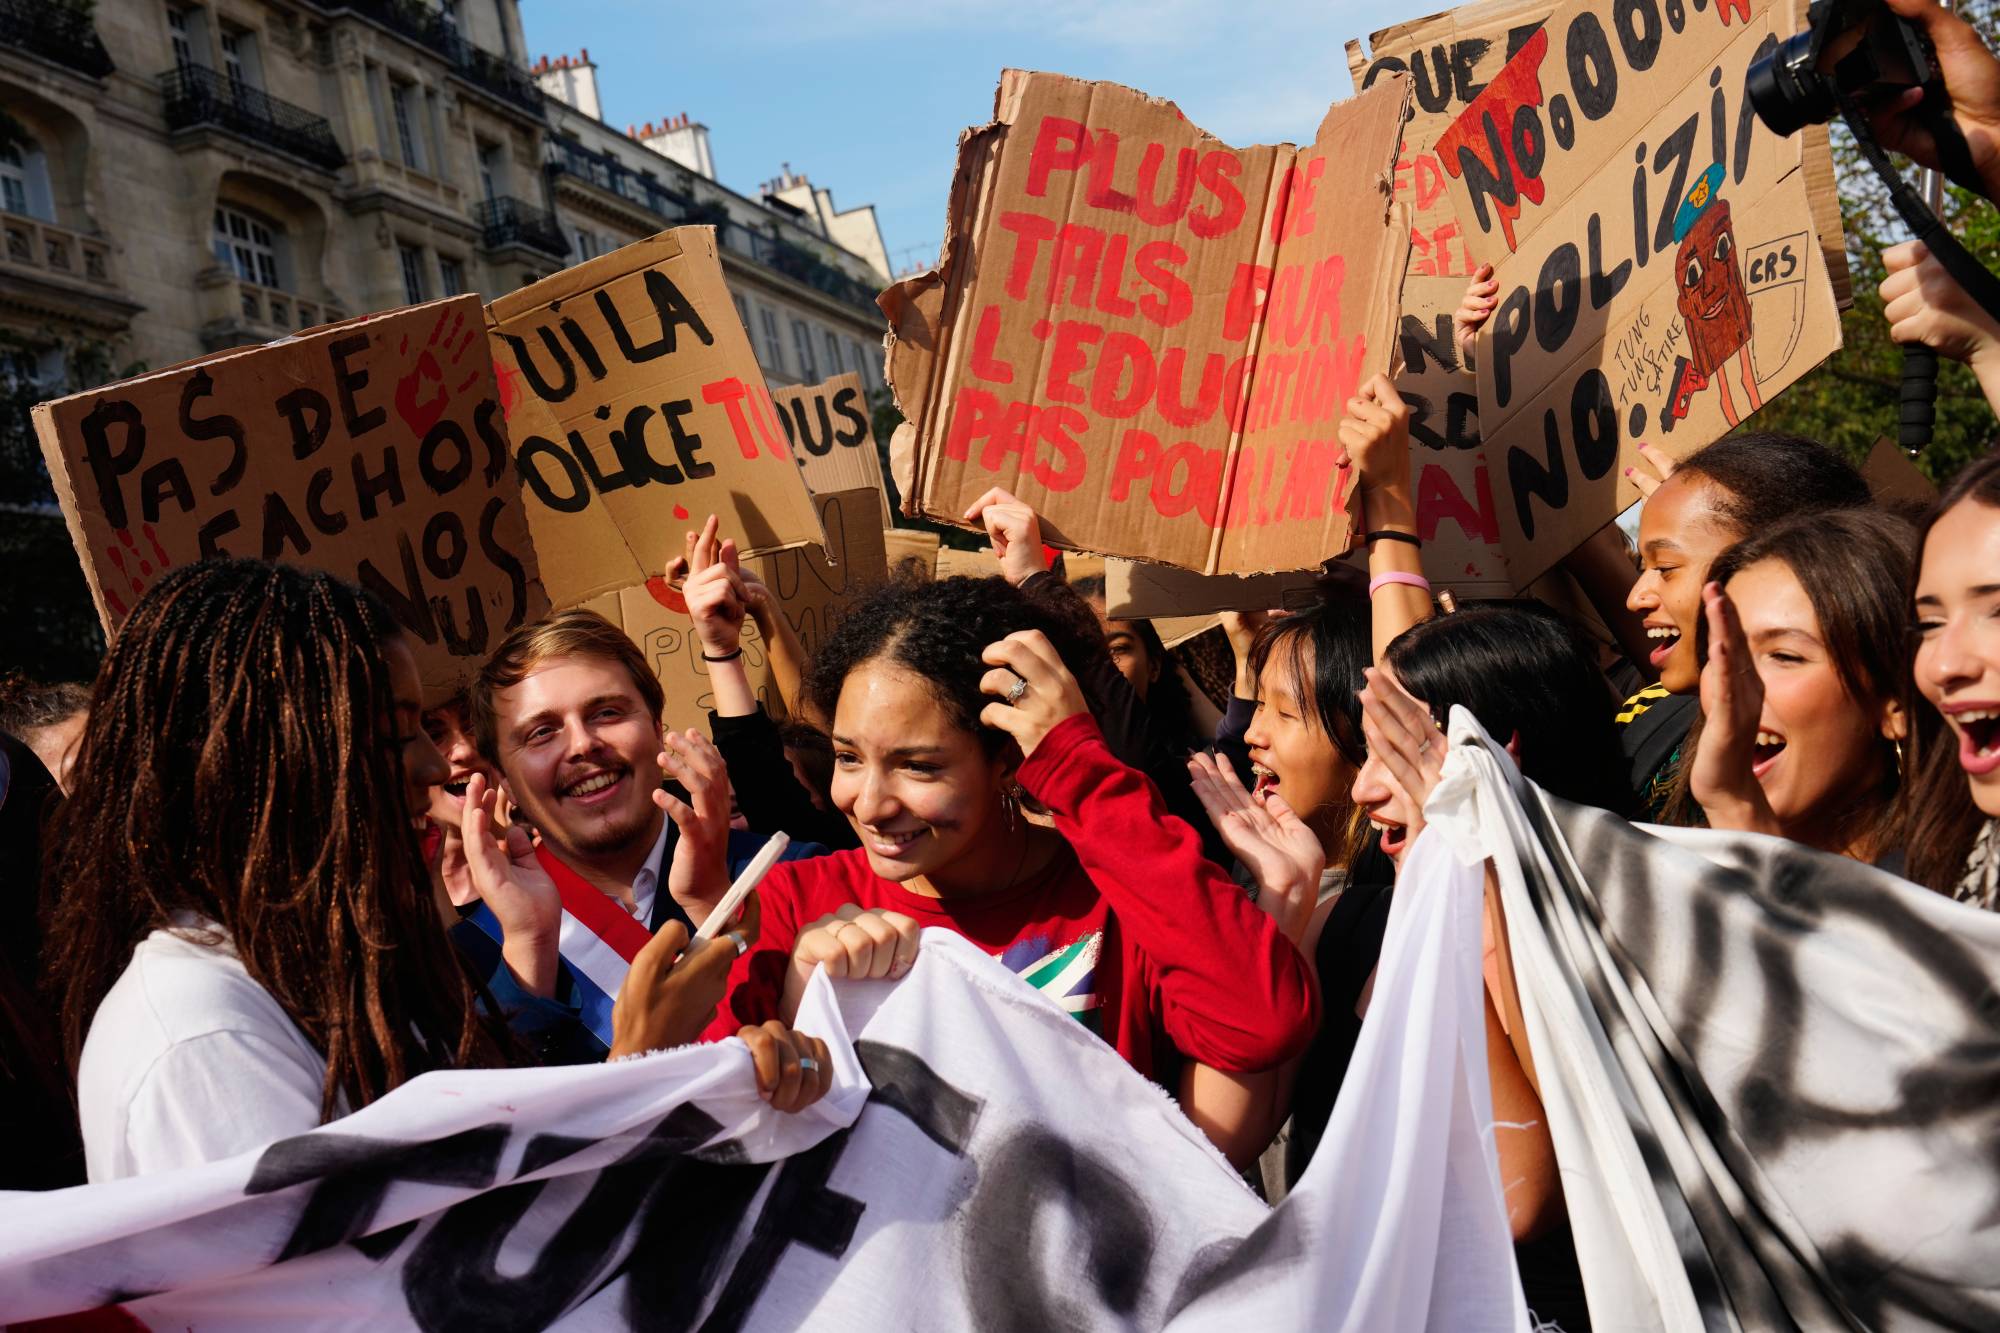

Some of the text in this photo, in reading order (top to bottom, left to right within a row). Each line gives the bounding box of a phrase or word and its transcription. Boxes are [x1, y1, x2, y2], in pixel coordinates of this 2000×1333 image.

[1025, 115, 1325, 246] PLUS DE
[1222, 255, 1345, 347] POUR
[1750, 245, 1797, 284] CRS
[594, 269, 713, 363] LA
[1615, 304, 1650, 370] TUNG
[1647, 314, 1684, 397] SATIRE
[1620, 342, 1655, 405] TUNG
[81, 332, 388, 530] PAS DE
[944, 387, 1089, 492] PAS
[1110, 429, 1256, 529] POUR
[199, 398, 508, 564] FACHOS
